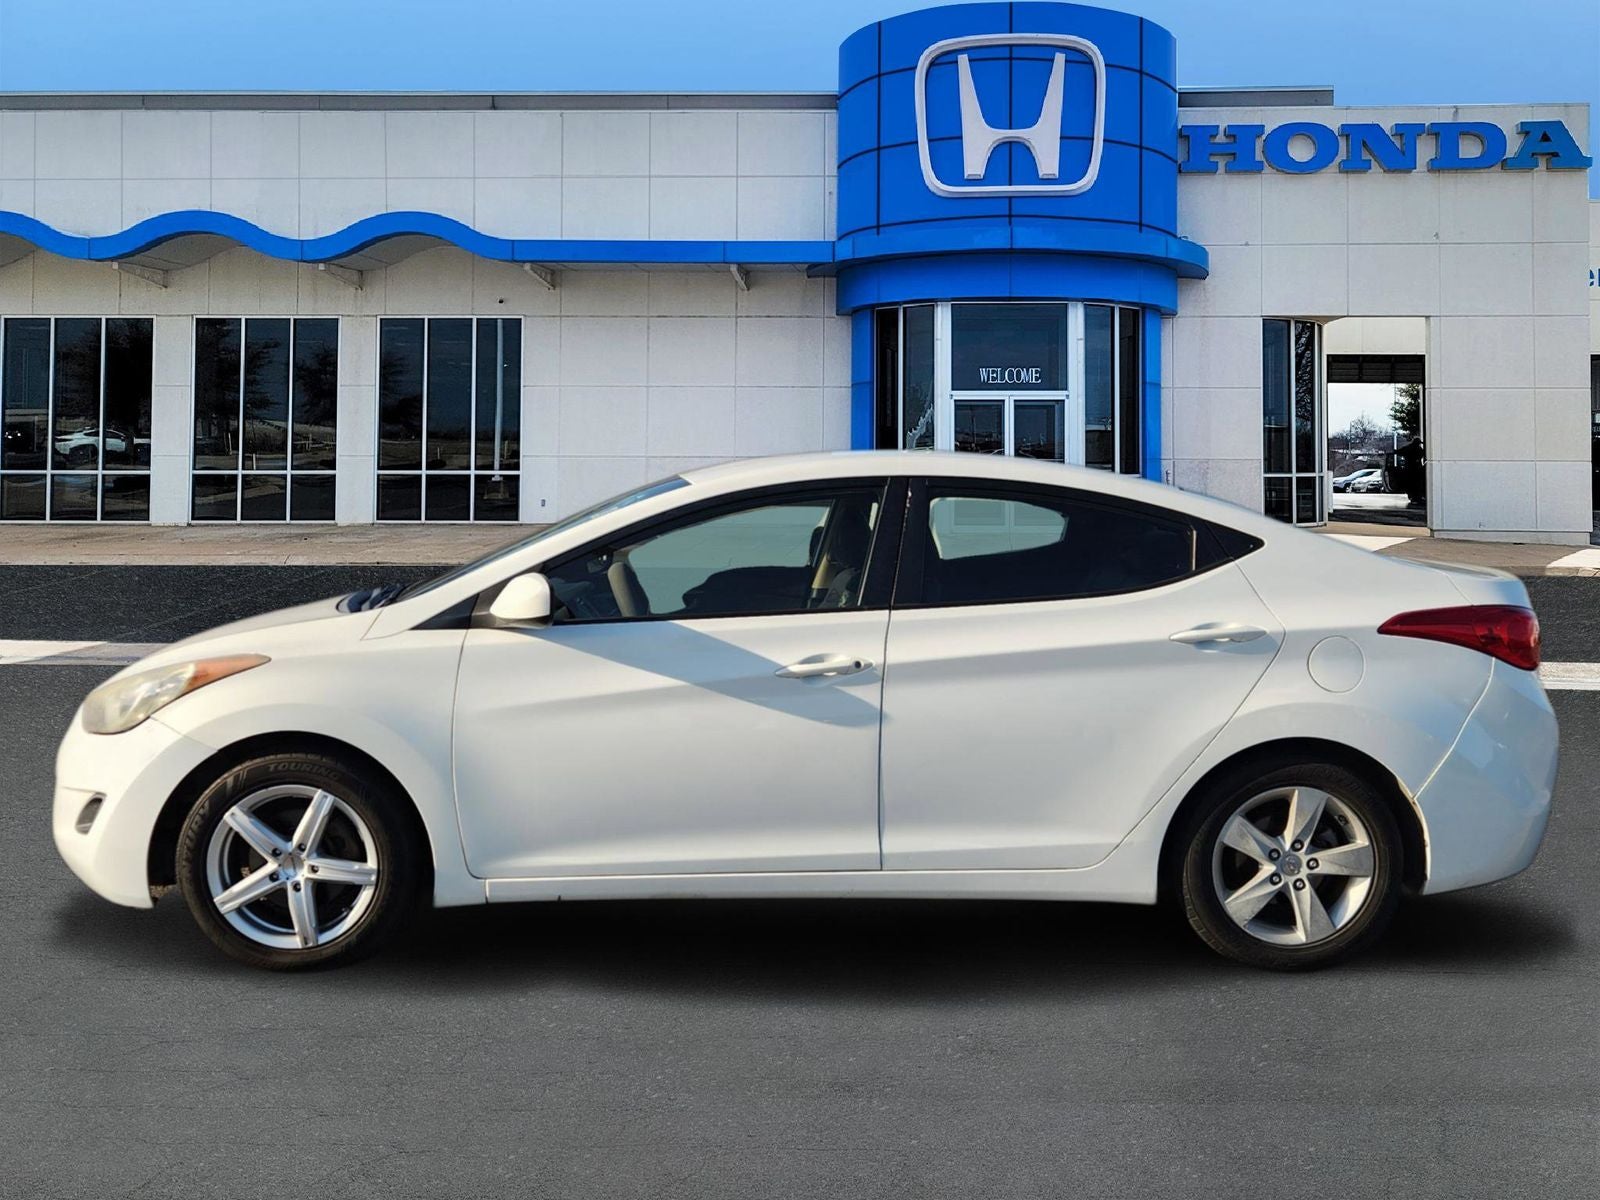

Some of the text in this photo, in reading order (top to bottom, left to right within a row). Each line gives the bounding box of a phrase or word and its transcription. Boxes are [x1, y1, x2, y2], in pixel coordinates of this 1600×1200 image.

[1178, 120, 1592, 173] HONDA
[979, 367, 1041, 384] WELCOME
[268, 762, 341, 781] TOURING
